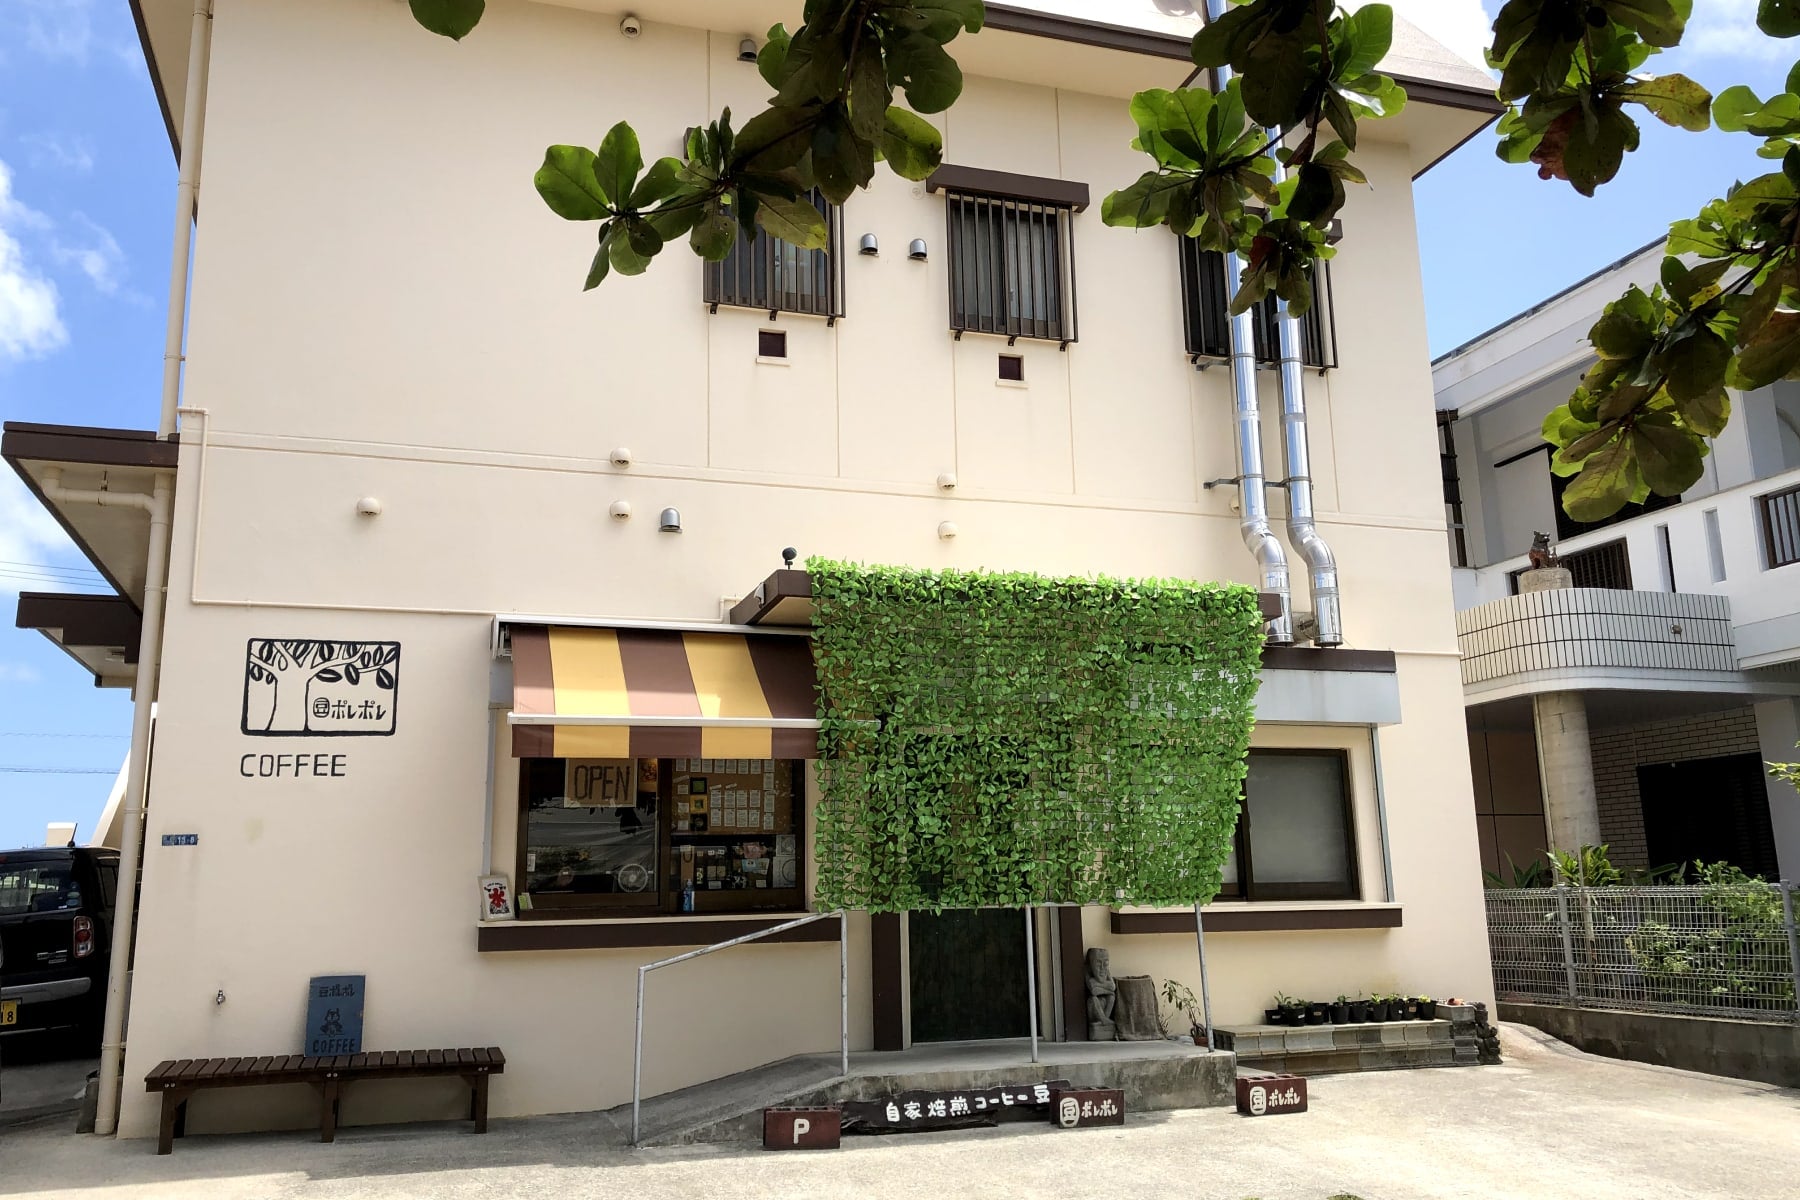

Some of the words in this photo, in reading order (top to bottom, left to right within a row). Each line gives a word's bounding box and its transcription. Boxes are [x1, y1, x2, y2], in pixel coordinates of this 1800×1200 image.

[240, 753, 347, 777] COFFEE
[574, 765, 631, 800] OPEN
[312, 1038, 356, 1054] COFFEE
[793, 1118, 810, 1144] P
